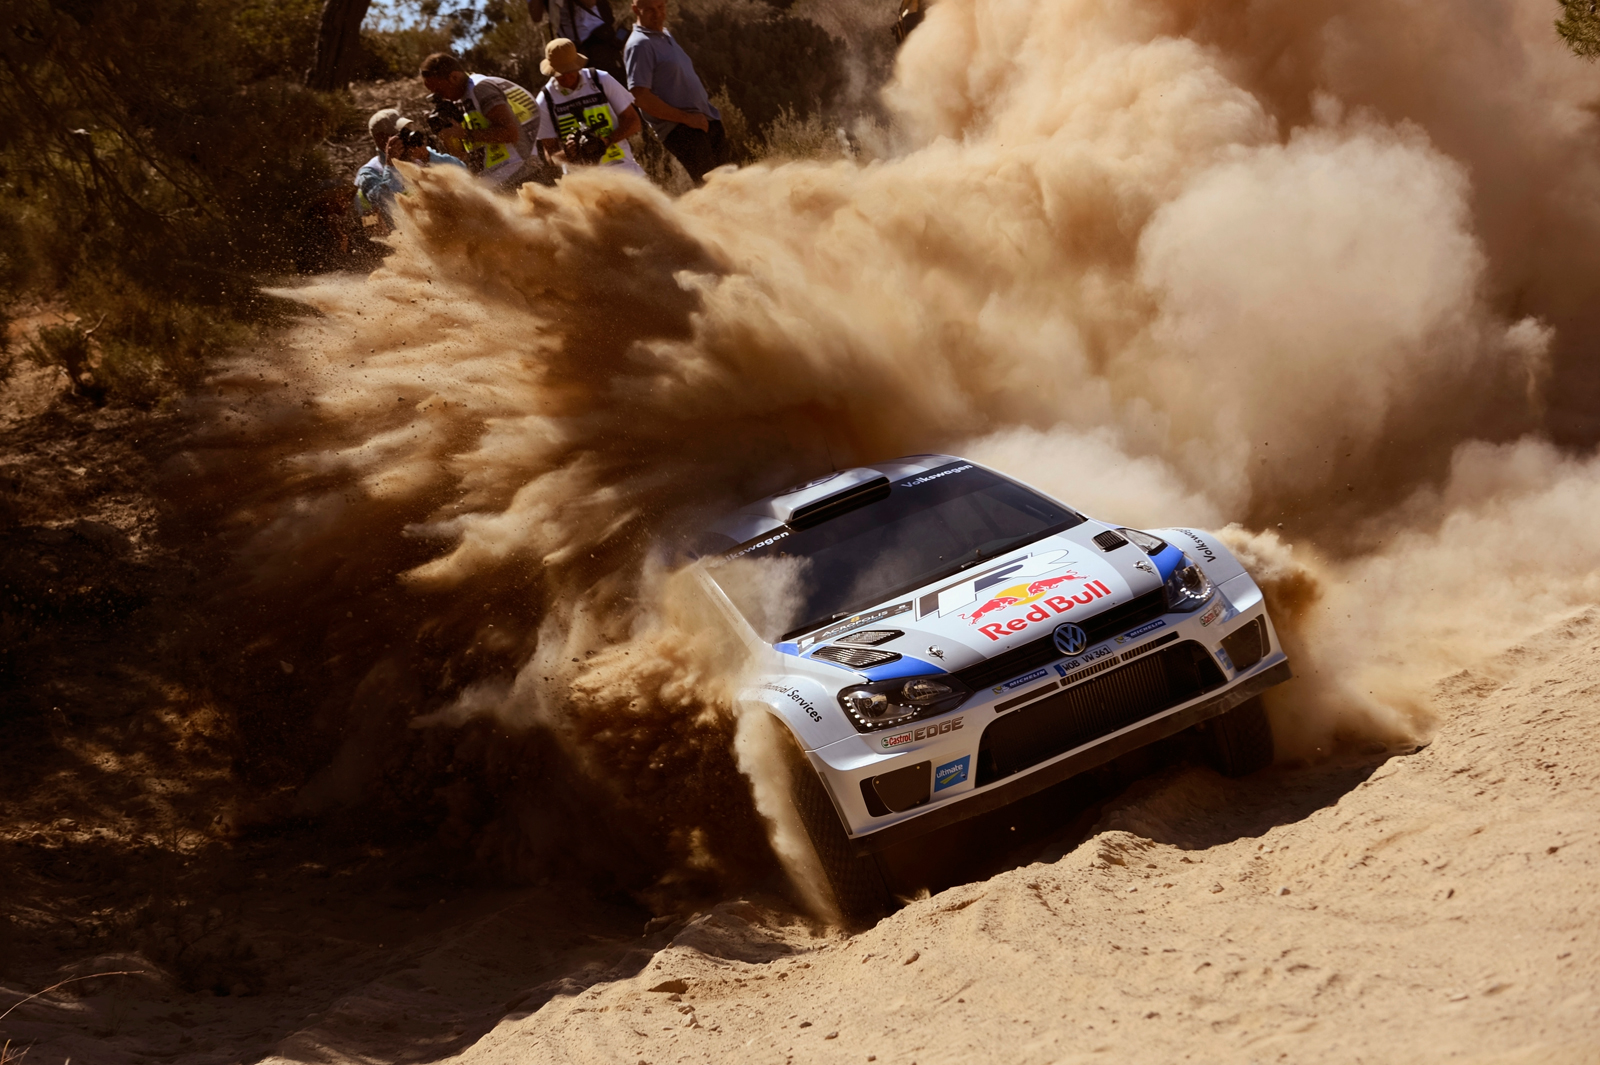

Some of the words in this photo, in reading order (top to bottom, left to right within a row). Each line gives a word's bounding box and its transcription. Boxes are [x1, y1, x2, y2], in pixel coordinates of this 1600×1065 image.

[901, 464, 973, 487] Volkswagen
[977, 603, 1051, 641] Red
[1043, 579, 1112, 614] Bull
[1129, 619, 1163, 637] MICHELIN
[1062, 660, 1080, 671] WOB
[1081, 653, 1095, 663] VW
[1093, 647, 1111, 658] 361
[1009, 669, 1046, 687] MICHELIN
[787, 689, 822, 723] Services
[889, 733, 911, 746] Castrol
[914, 716, 964, 741] EDGE
[936, 764, 963, 778] ultimate
